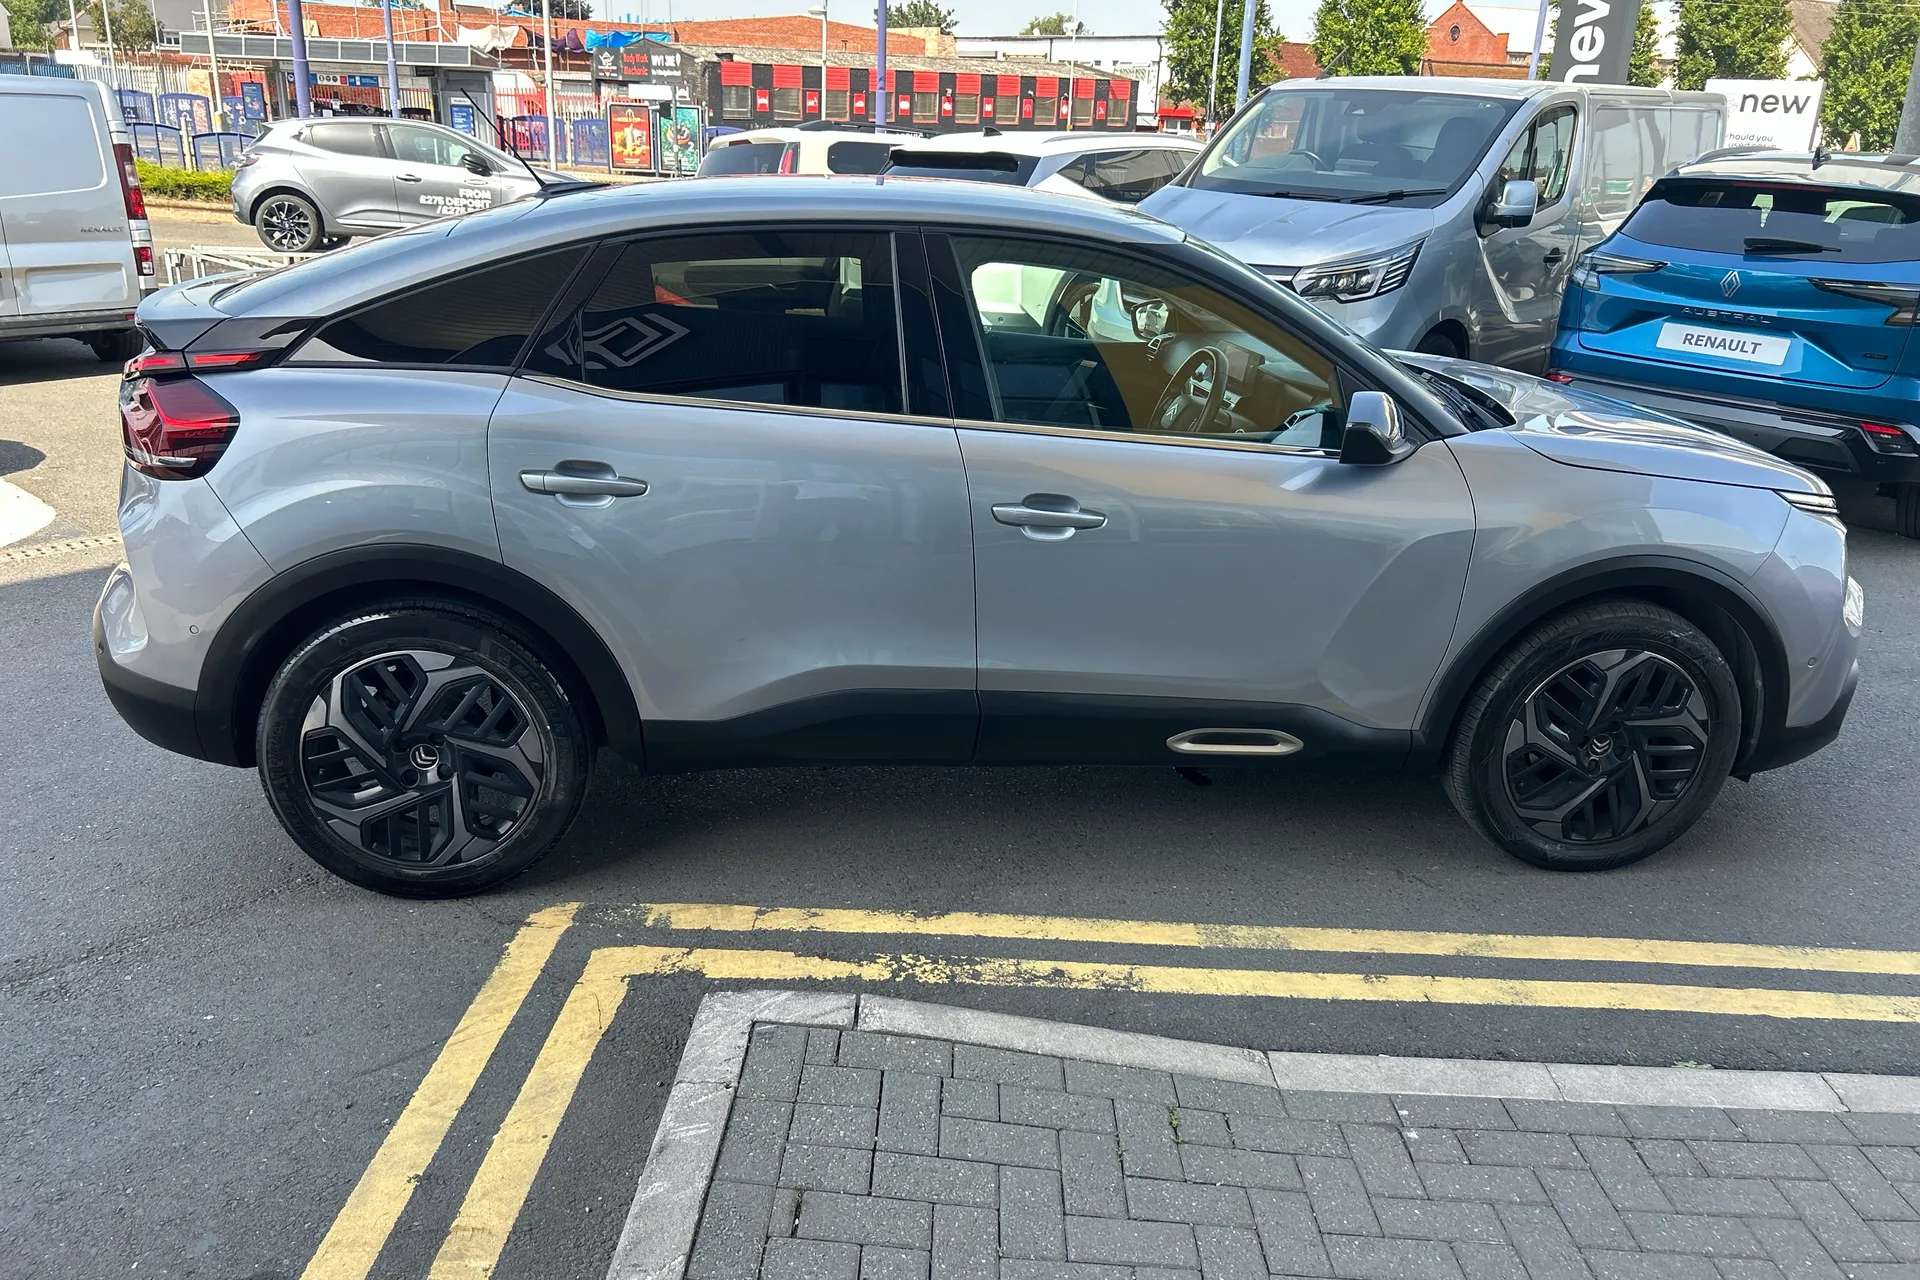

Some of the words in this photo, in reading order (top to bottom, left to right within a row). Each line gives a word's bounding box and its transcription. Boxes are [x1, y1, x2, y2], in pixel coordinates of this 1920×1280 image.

[1740, 93, 1812, 114] new
[1756, 134, 1774, 143] you
[459, 188, 491, 199] FROM
[445, 197, 491, 208] DEPOSIT
[1681, 307, 1772, 324] AUSTRAL
[1682, 332, 1763, 355] RENAULT
